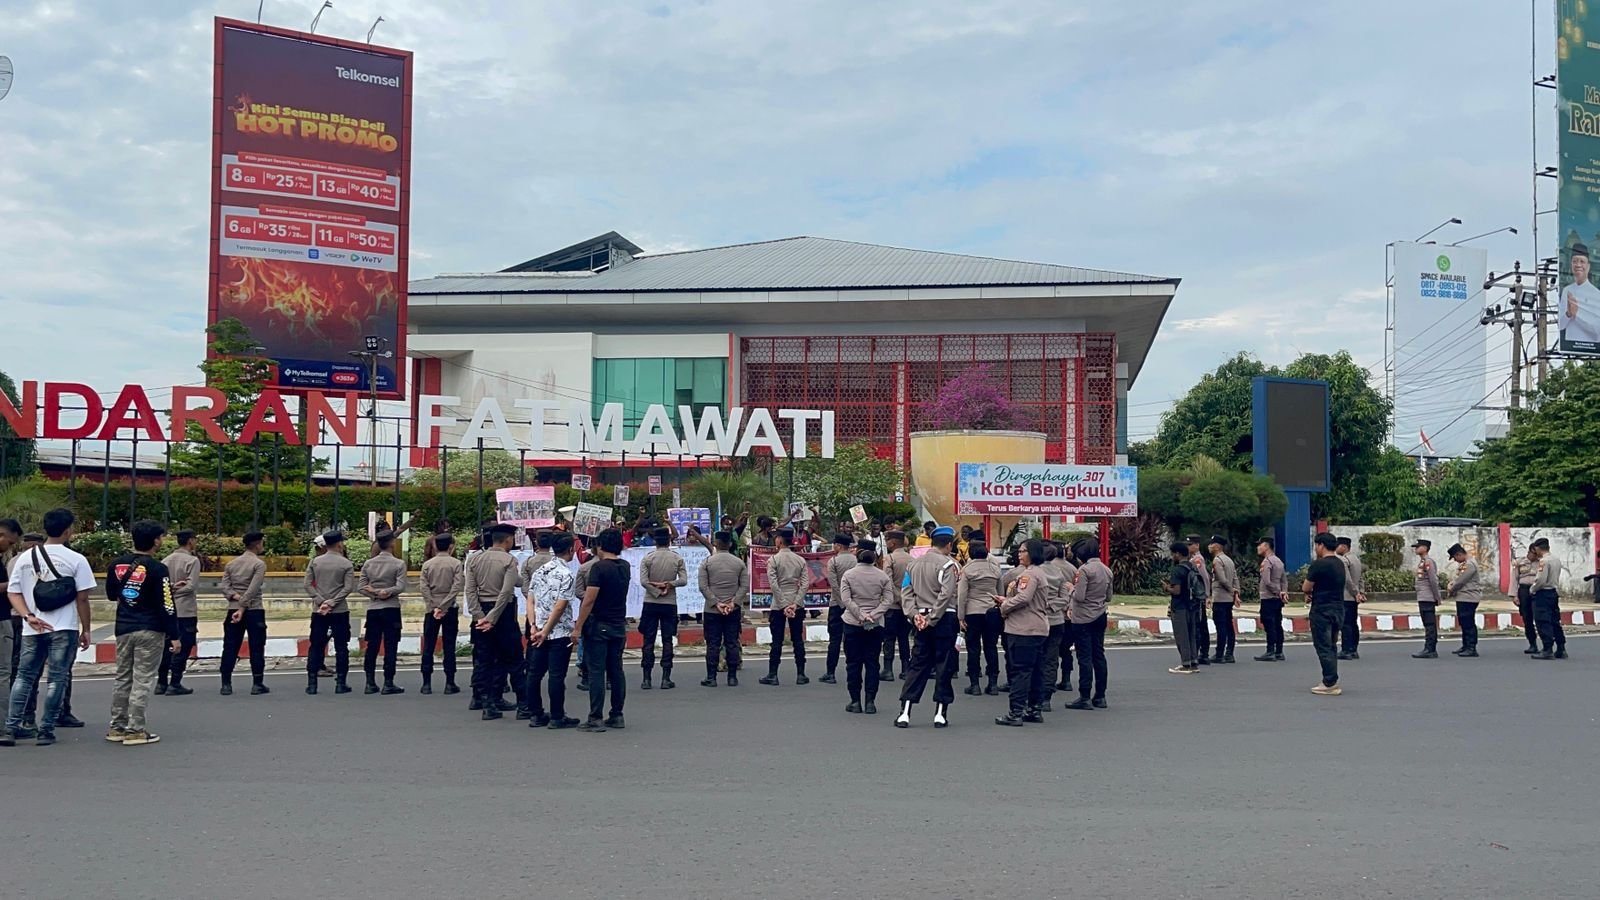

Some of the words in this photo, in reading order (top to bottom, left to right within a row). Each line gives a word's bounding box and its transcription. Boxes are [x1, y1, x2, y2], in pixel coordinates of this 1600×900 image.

[335, 66, 399, 87] Telkomsel
[251, 104, 279, 116] Kini
[282, 107, 329, 121] Semua
[330, 113, 359, 127] Bisa
[360, 119, 385, 132] Beli
[237, 113, 296, 135] HOT
[301, 120, 398, 152] PROMO
[236, 244, 267, 252] Termasuk
[361, 255, 383, 264] WeTV
[1440, 275, 1466, 283] AVAILABLE
[292, 369, 328, 377] MyTelkomsel
[418, 393, 835, 459] FATMAWATI
[994, 465, 1081, 487] Dirgahayu
[1082, 472, 1105, 482] 307
[981, 482, 1024, 497] Kota
[1030, 482, 1117, 500] Bengkulu
[987, 504, 1007, 513] Terus
[1008, 505, 1040, 514] Berkarya
[1062, 505, 1094, 514] Bengkulu
[1094, 506, 1112, 515] Maju
